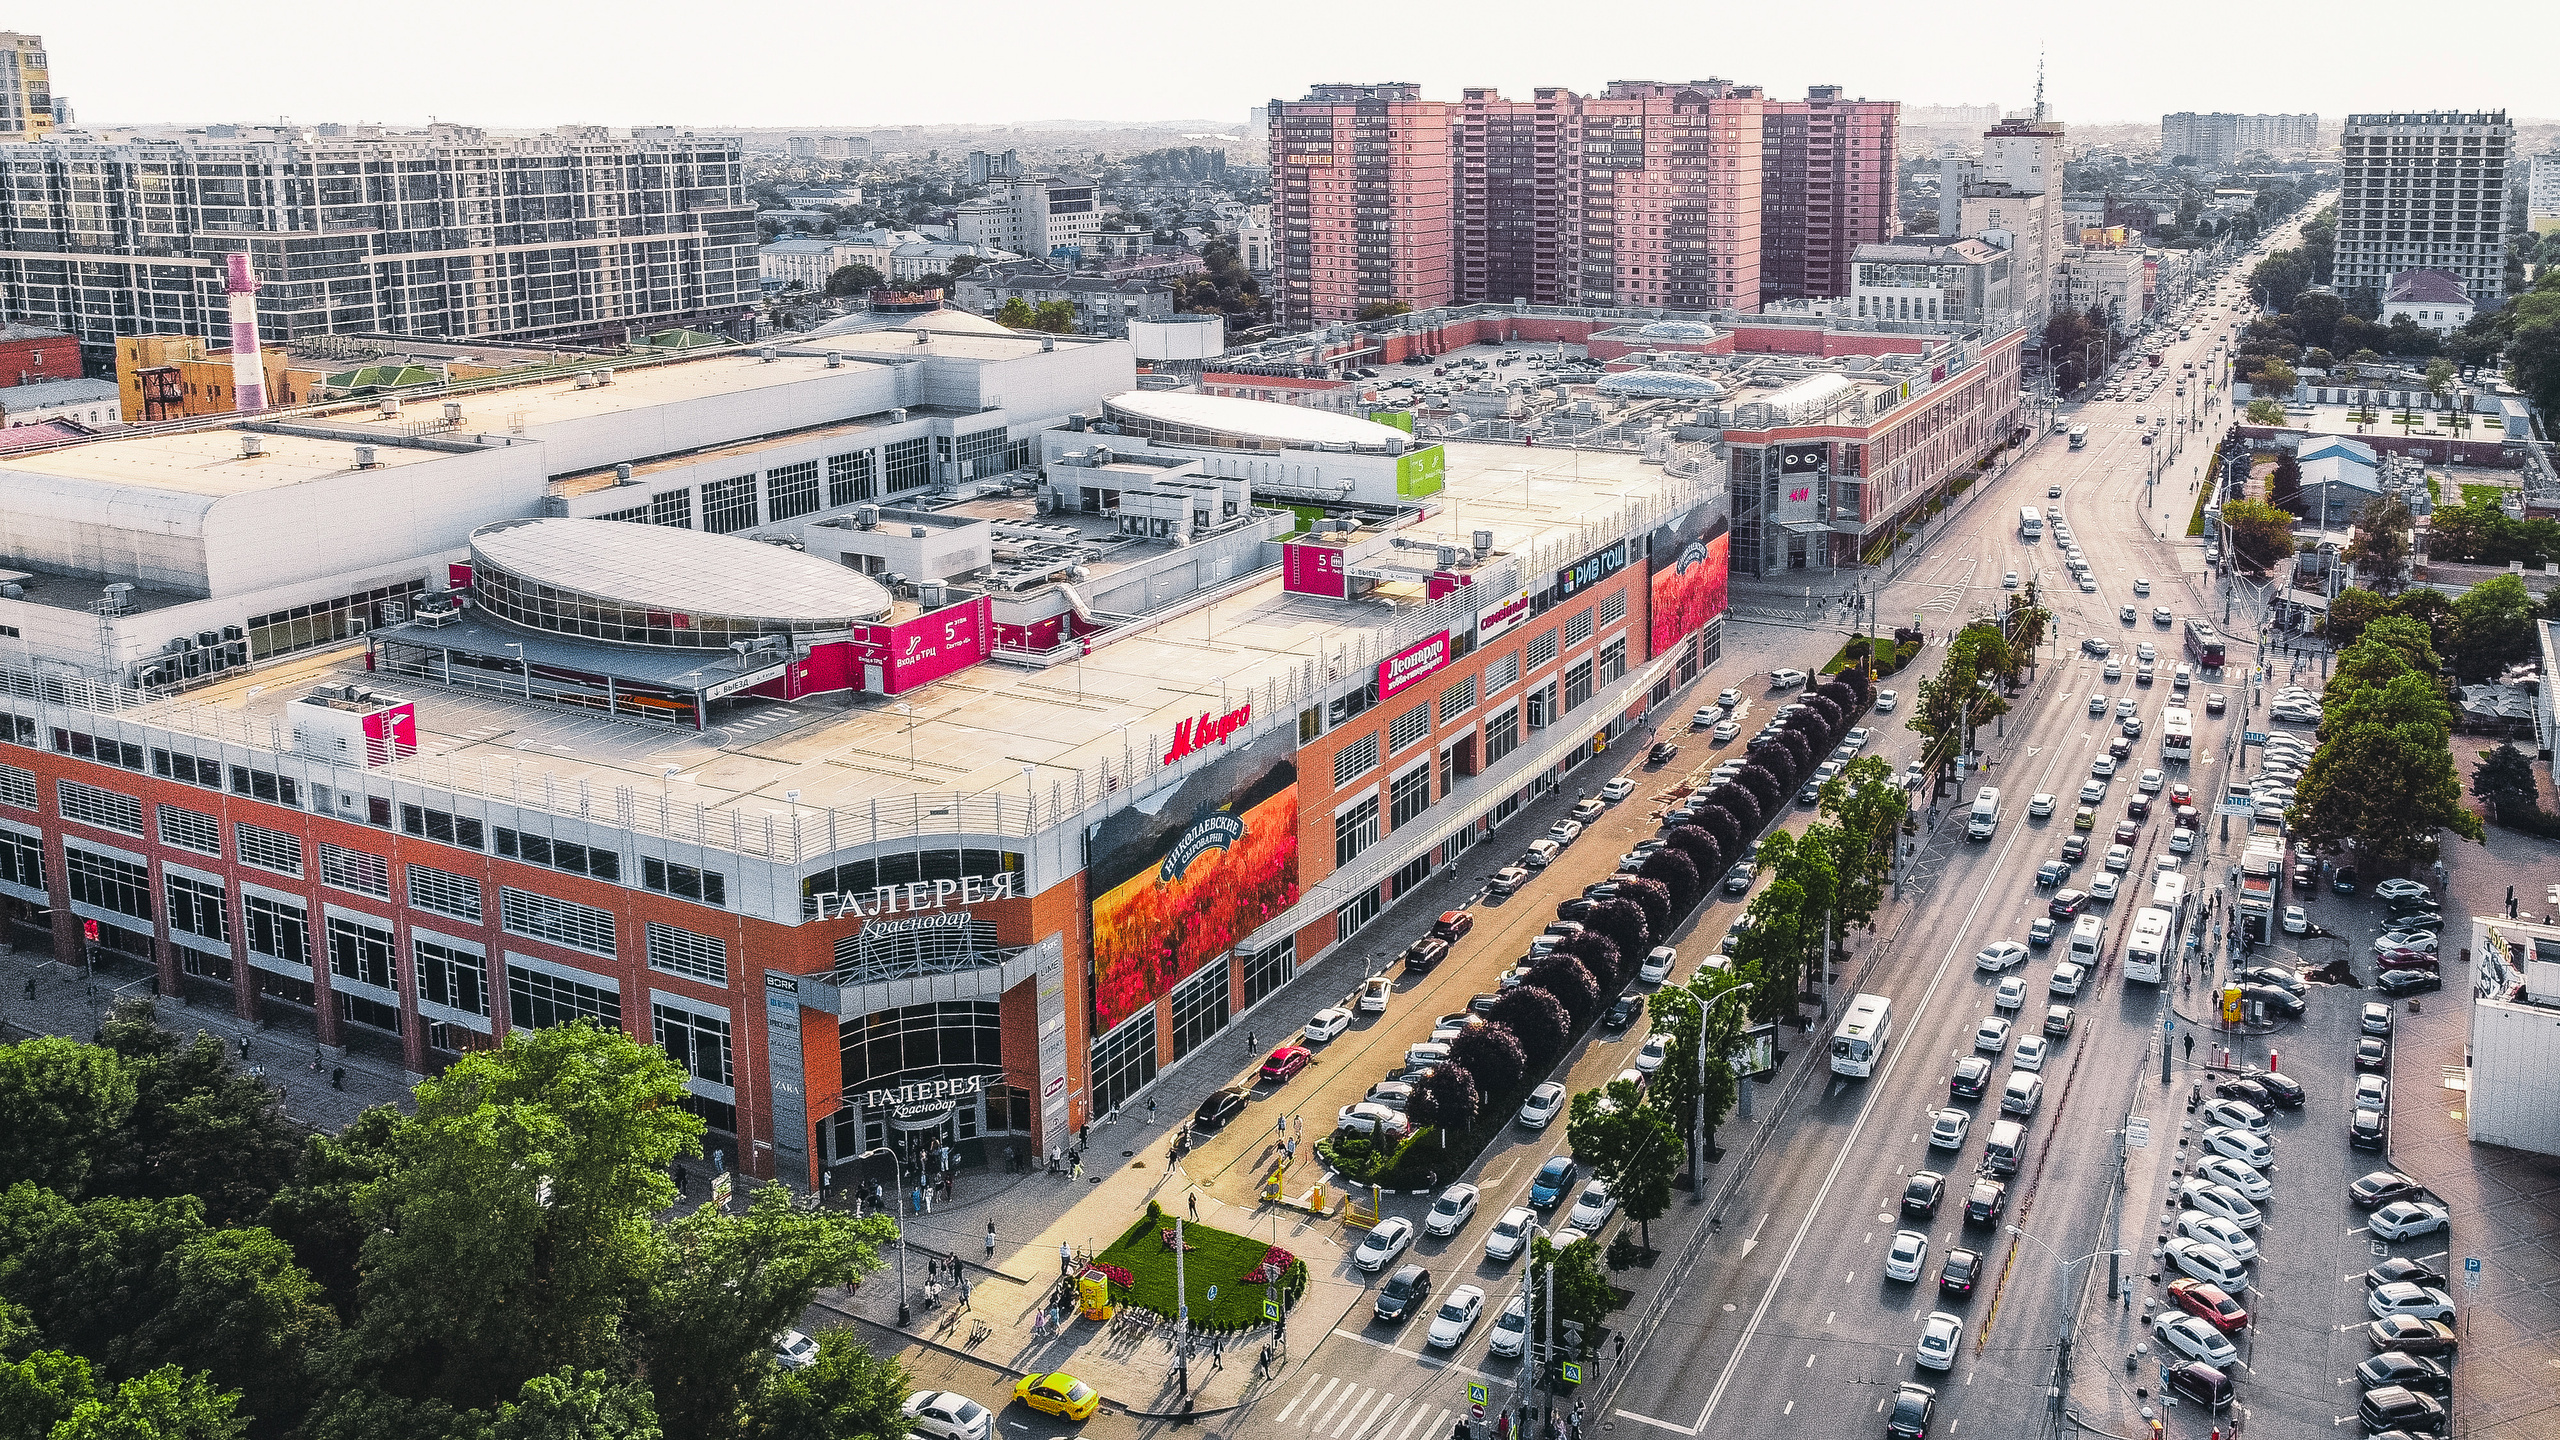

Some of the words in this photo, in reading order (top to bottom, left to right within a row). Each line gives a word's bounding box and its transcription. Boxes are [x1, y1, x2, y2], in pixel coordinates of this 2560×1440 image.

[1418, 459, 1424, 472] 5
[1318, 554, 1327, 566] 5
[1576, 557, 1599, 588] РИВ
[1601, 544, 1624, 575] ГОШ
[944, 621, 955, 641] 5
[920, 646, 937, 660] ТРЦ
[1387, 639, 1444, 680] Леонардо
[723, 679, 749, 693] ВЫЕЗД
[1164, 816, 1239, 875] НИКОЛАЕВСКИЕ
[1181, 833, 1224, 864] СЫРОВАРНИ
[813, 871, 1016, 922] ГАЛЕРЕЯ
[860, 911, 971, 940] Краснодар
[767, 976, 795, 991] BORK
[867, 1074, 982, 1108] ГАЛЕРЕЯ
[892, 1099, 956, 1118] Краснодар
